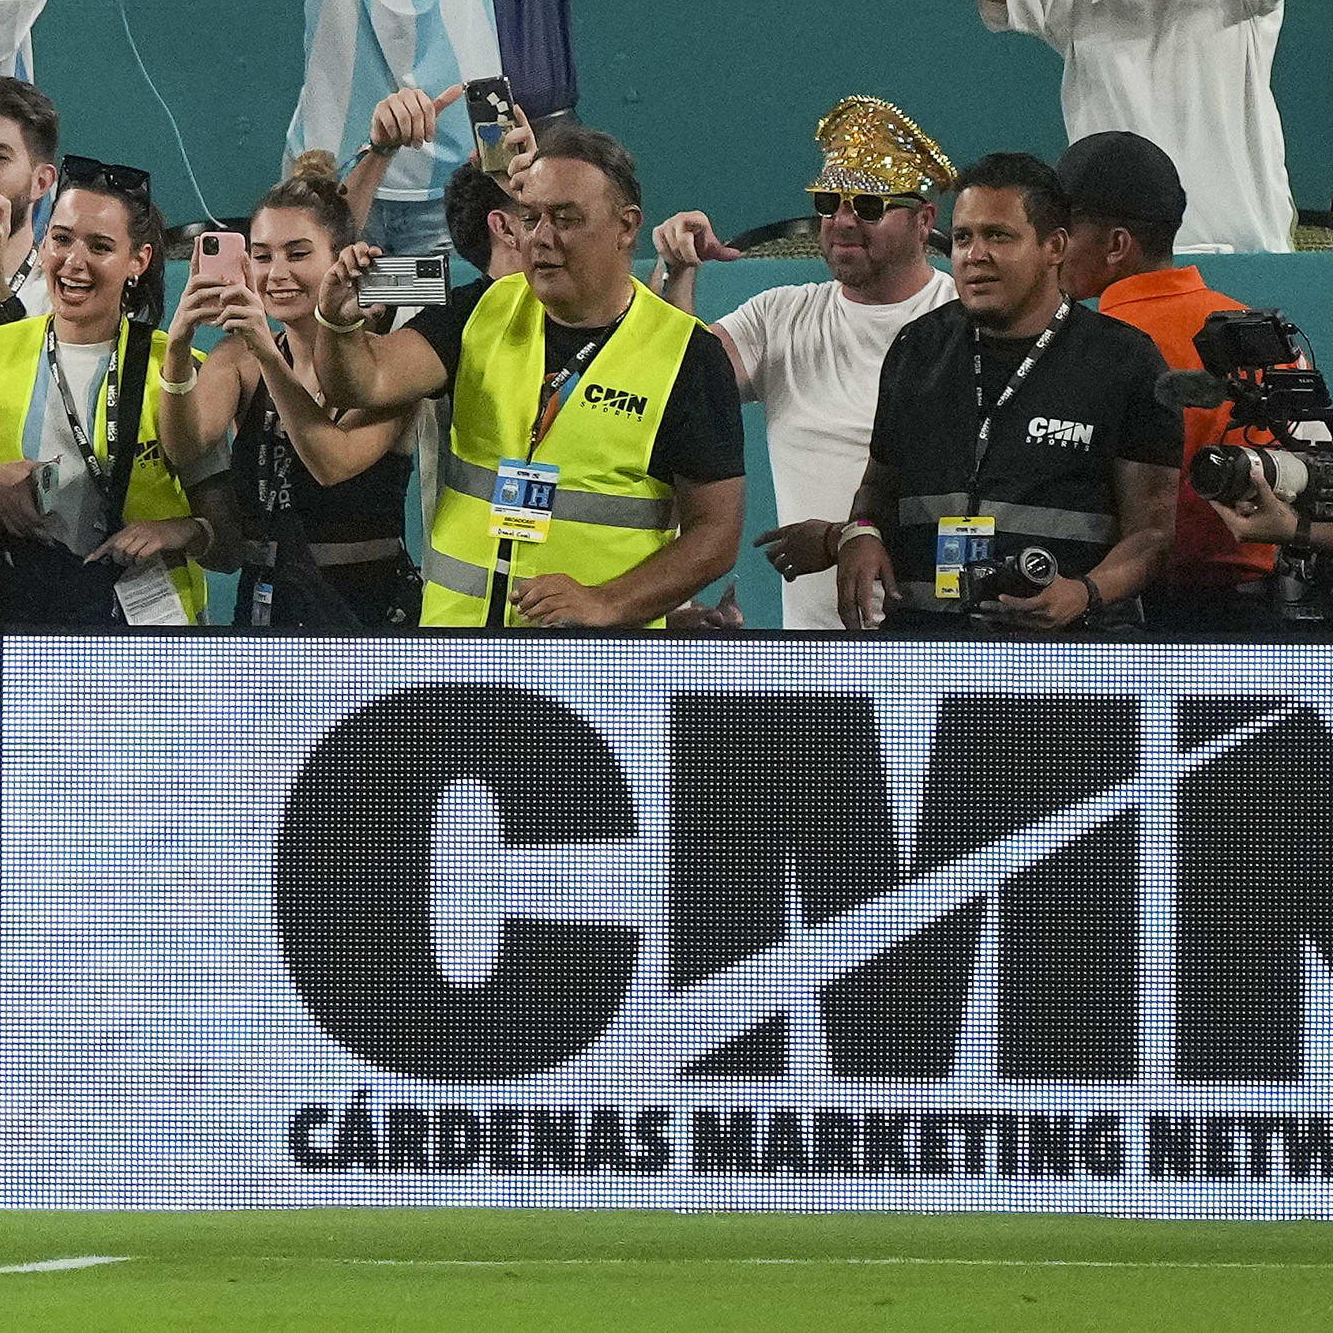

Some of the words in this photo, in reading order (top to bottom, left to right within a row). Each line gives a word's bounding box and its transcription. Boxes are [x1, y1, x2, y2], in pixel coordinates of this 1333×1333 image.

[580, 401, 643, 423] SPORTS
[584, 383, 649, 416] CMN
[1025, 435, 1091, 452] SPORTS
[1028, 417, 1095, 445] CMN
[288, 1089, 670, 1174] CÁRDENAS
[692, 1112, 1122, 1178] MARKETING
